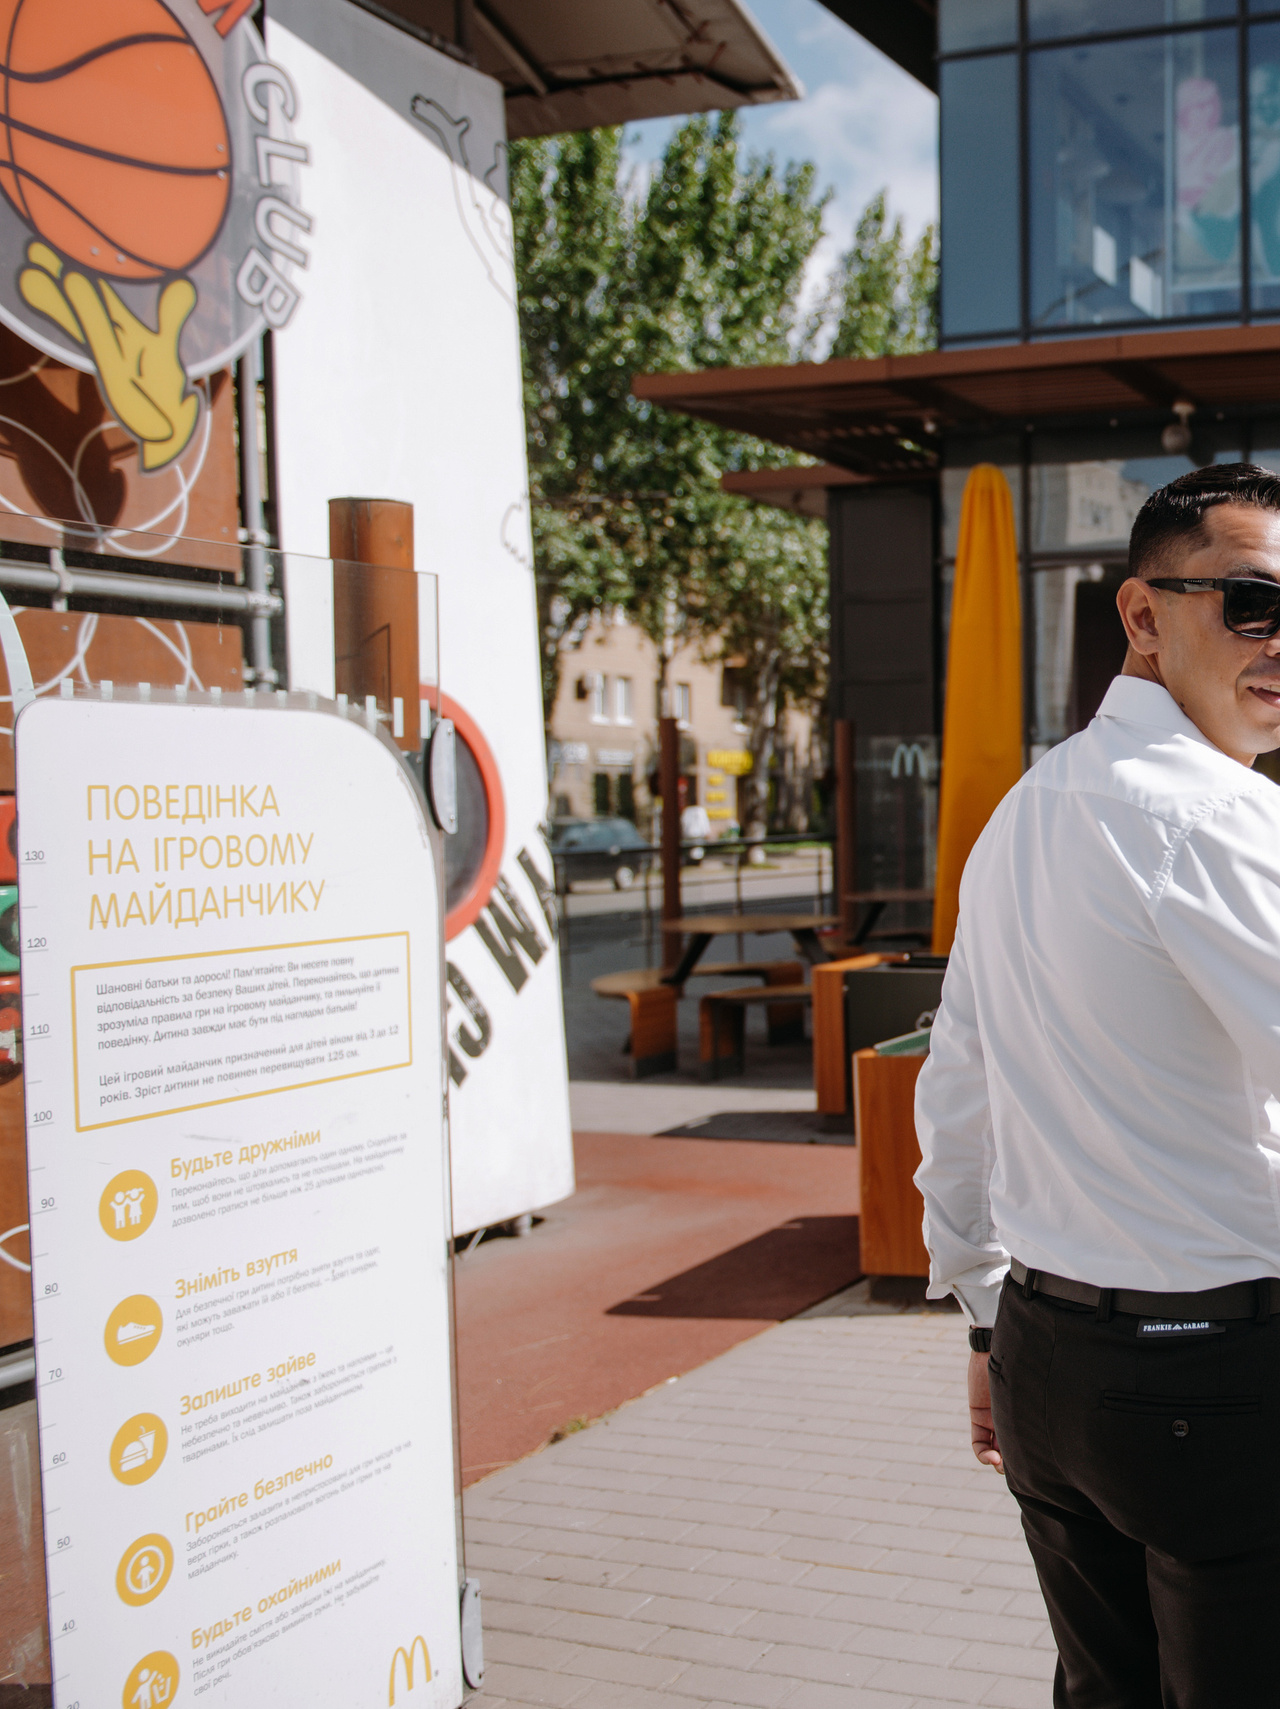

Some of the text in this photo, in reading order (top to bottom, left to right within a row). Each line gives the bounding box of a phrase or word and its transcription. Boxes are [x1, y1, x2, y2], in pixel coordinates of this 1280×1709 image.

[236, 62, 314, 331] CLUB
[88, 785, 279, 824] ПОВЕДІНКА
[24, 850, 45, 861] 130
[89, 833, 313, 875] НА ІГРОВОМУ
[90, 880, 324, 929] МАЙДАНЧИКУ
[26, 937, 47, 949] 120
[181, 975, 191, 984] та
[182, 993, 193, 1002] за
[96, 1015, 148, 1033] зрозуміла
[150, 1010, 192, 1025] правила
[194, 1008, 210, 1019] гри
[212, 1005, 224, 1015] на
[29, 1024, 50, 1036] 110
[152, 1028, 189, 1043] Дитина
[99, 1072, 120, 1087] Цей
[123, 1064, 163, 1083] ігровий
[166, 1057, 222, 1073] майданчик
[134, 1085, 161, 1098] Зріст
[201, 1075, 214, 1085] не
[32, 1110, 53, 1122] 100
[170, 1150, 233, 1180] Будьте
[238, 1130, 321, 1164] дружніми
[40, 1197, 55, 1209] 90
[175, 1268, 240, 1299] Зніміть
[246, 1248, 298, 1277] взуття
[44, 1282, 59, 1295] 80
[1143, 1322, 1210, 1332] FRANKIE GARAGE
[48, 1367, 63, 1380] 70
[180, 1373, 261, 1416] Залиште
[267, 1352, 316, 1382] зайве
[52, 1451, 67, 1465] 60
[185, 1492, 248, 1533] Грайте
[254, 1454, 333, 1500] безпечно
[56, 1535, 71, 1549] 50
[191, 1606, 252, 1649] Будьте
[257, 1559, 341, 1614] охайними
[61, 1619, 76, 1633] 40
